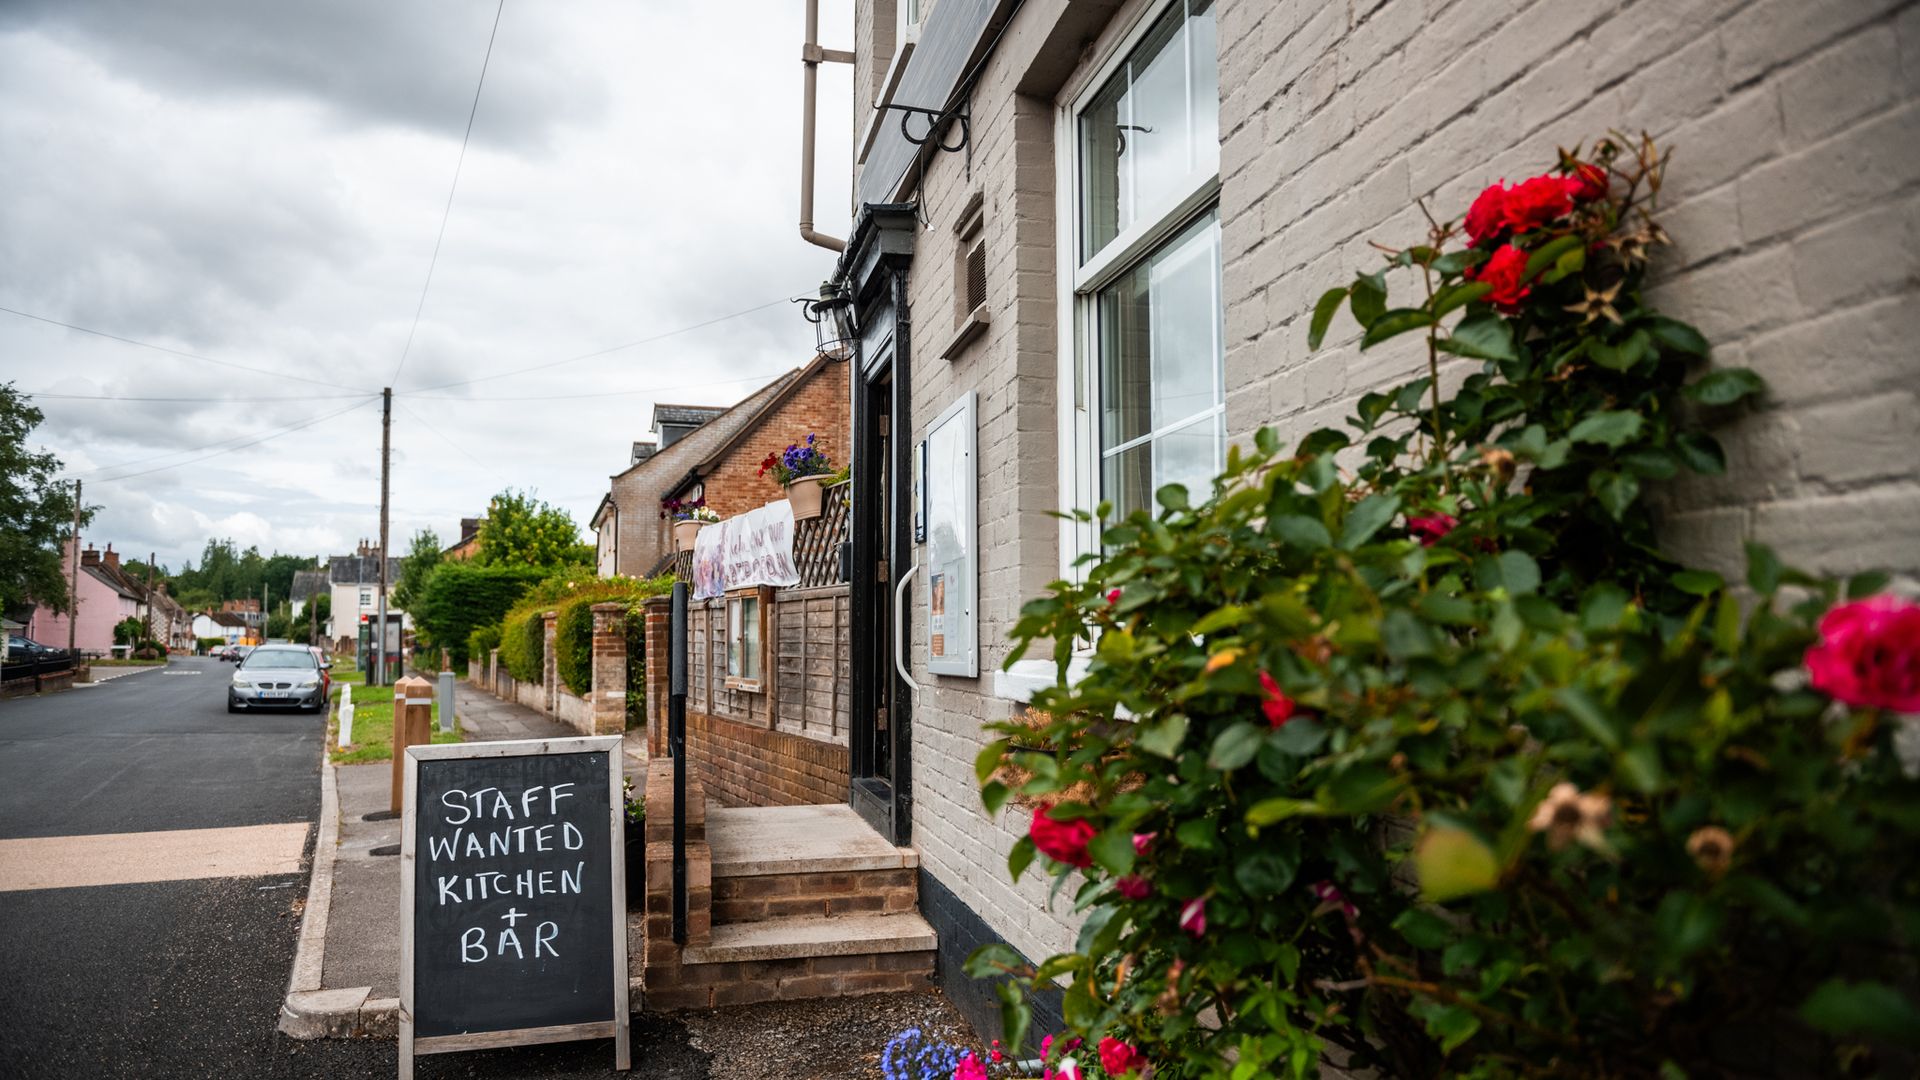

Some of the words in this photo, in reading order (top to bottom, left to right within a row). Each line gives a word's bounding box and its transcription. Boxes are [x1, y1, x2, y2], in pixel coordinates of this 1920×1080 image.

[441, 783, 575, 824] STAFF
[429, 821, 584, 862] WANTED
[437, 860, 586, 906] KITCHEN
[460, 921, 561, 963] BAR
